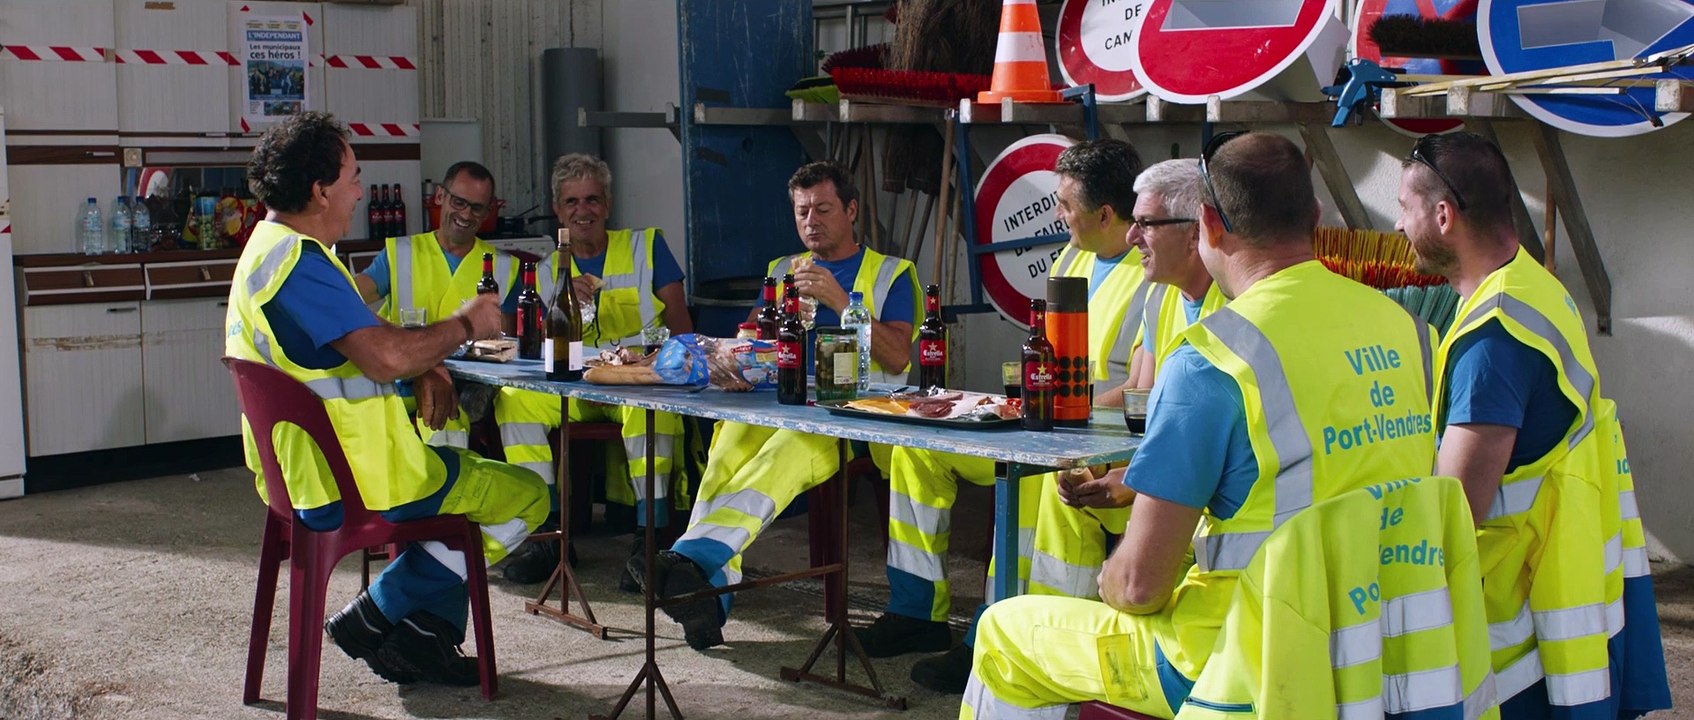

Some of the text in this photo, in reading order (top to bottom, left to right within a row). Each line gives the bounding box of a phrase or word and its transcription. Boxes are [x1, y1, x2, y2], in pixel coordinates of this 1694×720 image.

[250, 51, 265, 59] ces
[268, 50, 294, 59] héros
[1028, 258, 1047, 278] DU
[1344, 345, 1401, 375] Ville
[1370, 380, 1395, 408] de
[1323, 409, 1432, 455] Port-Vendres
